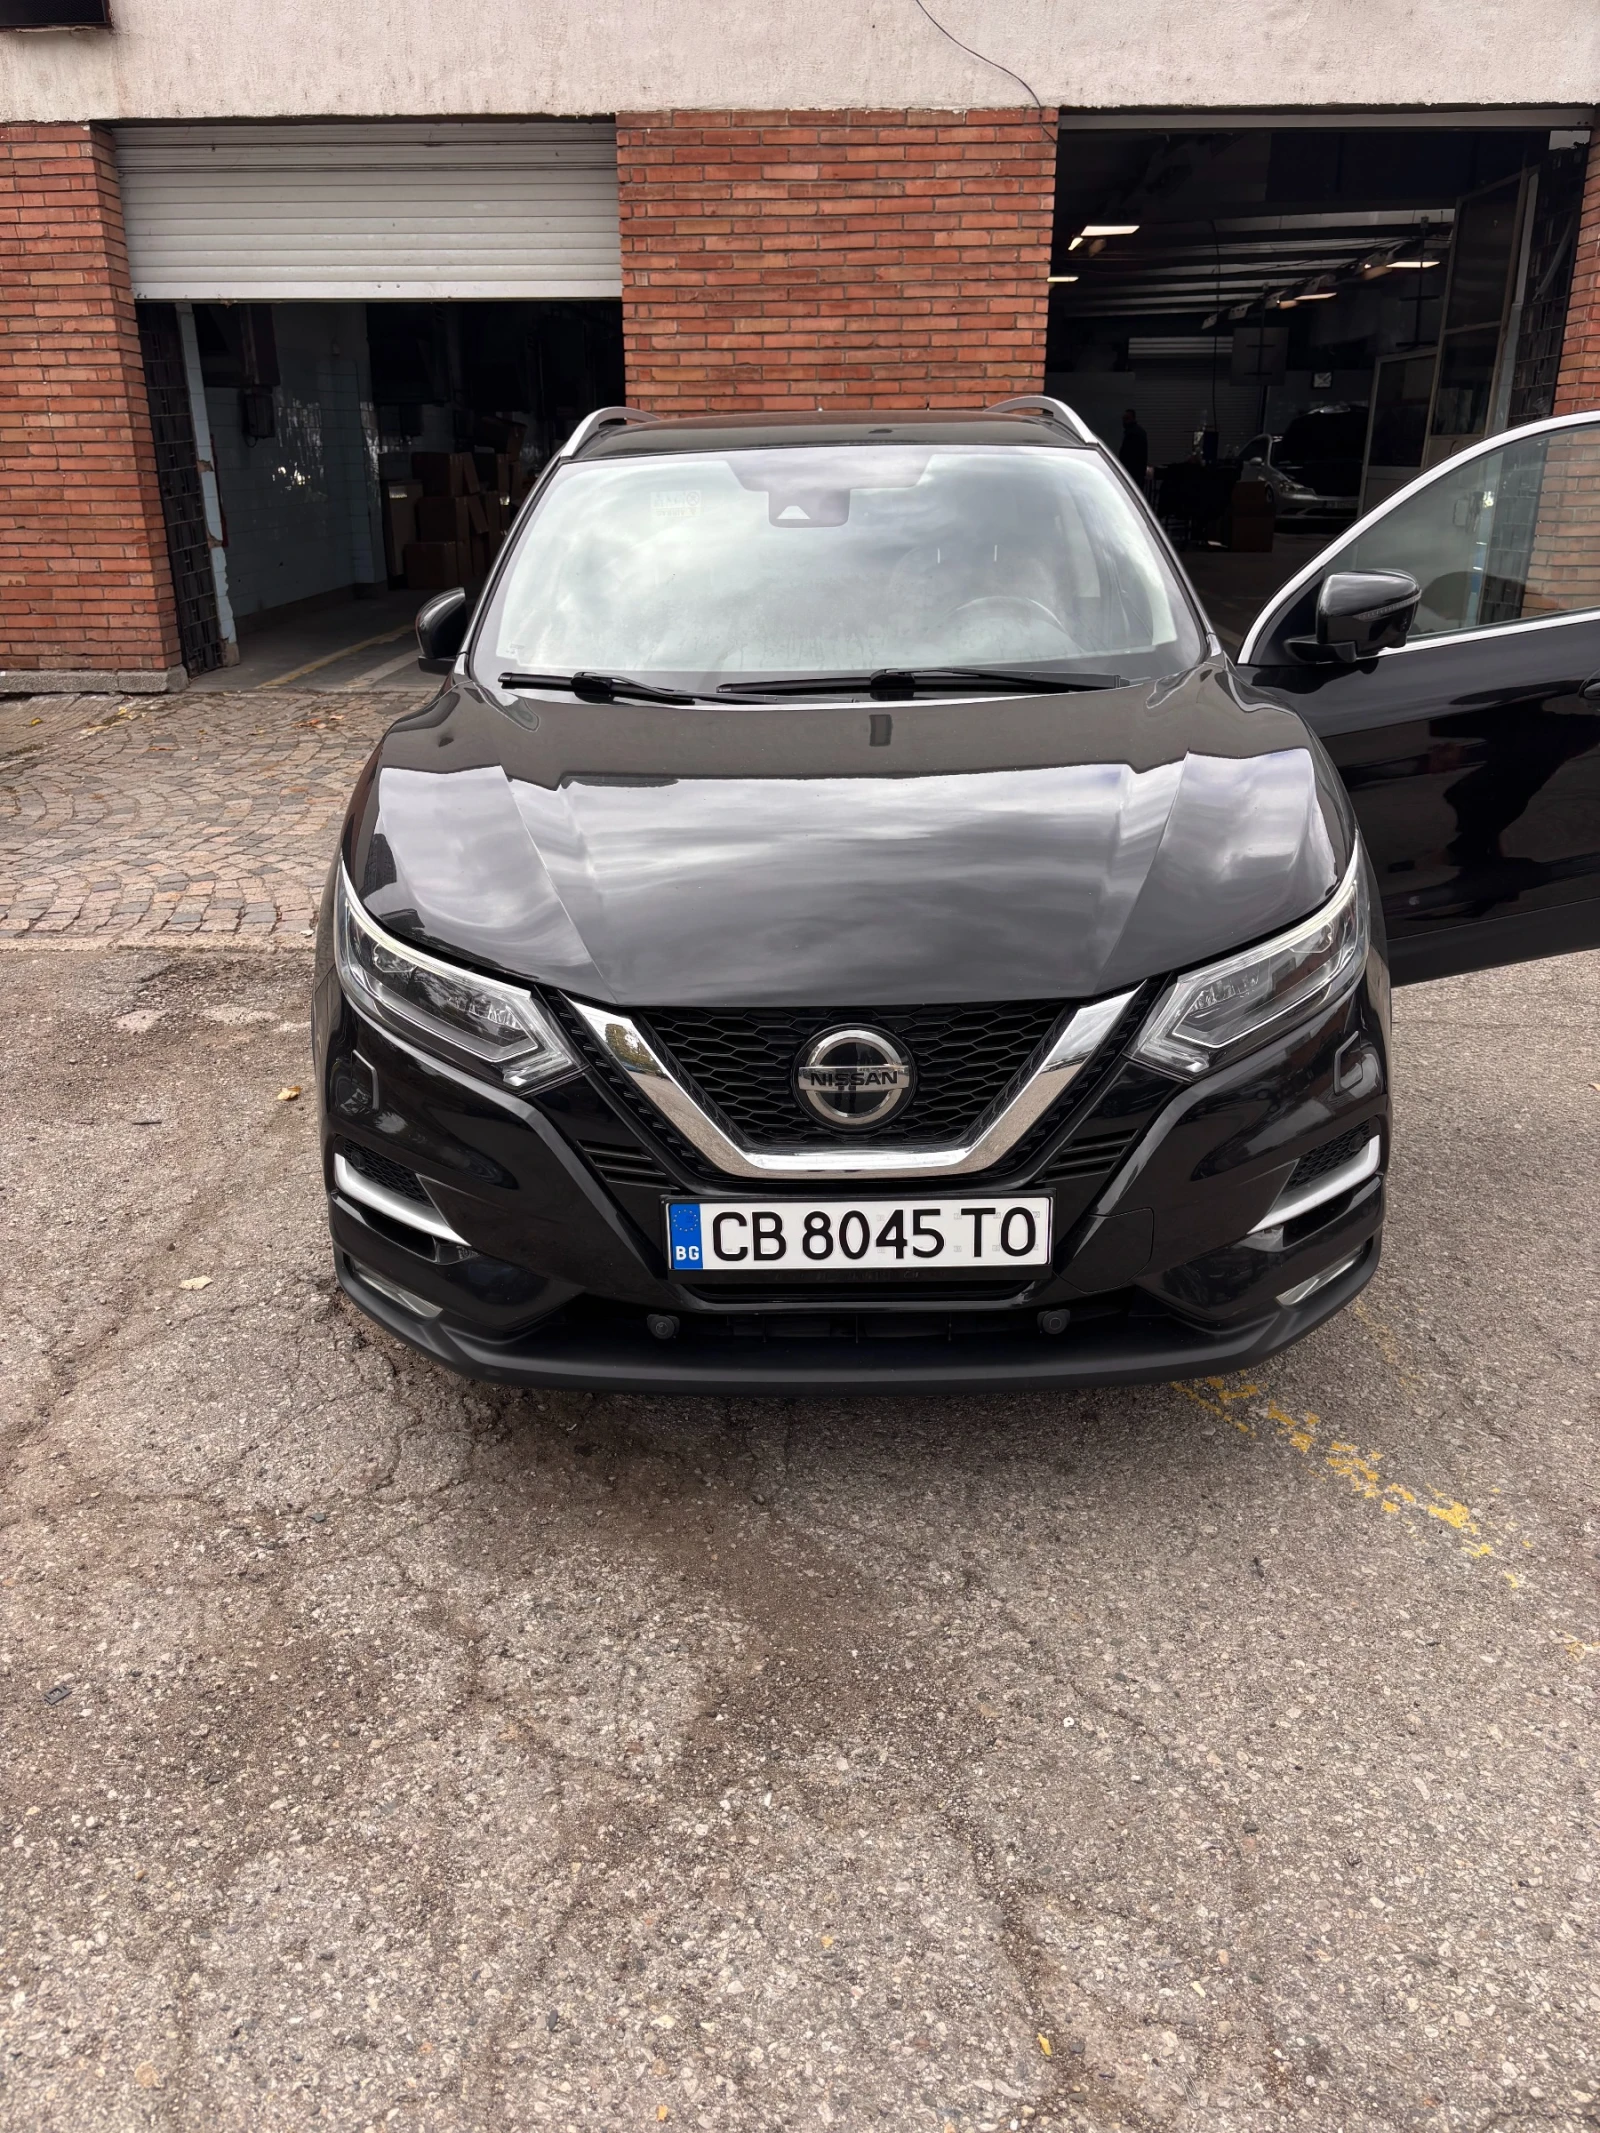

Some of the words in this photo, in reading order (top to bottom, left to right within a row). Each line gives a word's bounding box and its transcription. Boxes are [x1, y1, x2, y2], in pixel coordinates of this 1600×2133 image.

[811, 1071, 898, 1086] NISSAN
[713, 1211, 787, 1262] CB
[802, 1209, 945, 1261] 8045
[961, 1207, 1036, 1257] TO
[675, 1246, 700, 1261] BG
